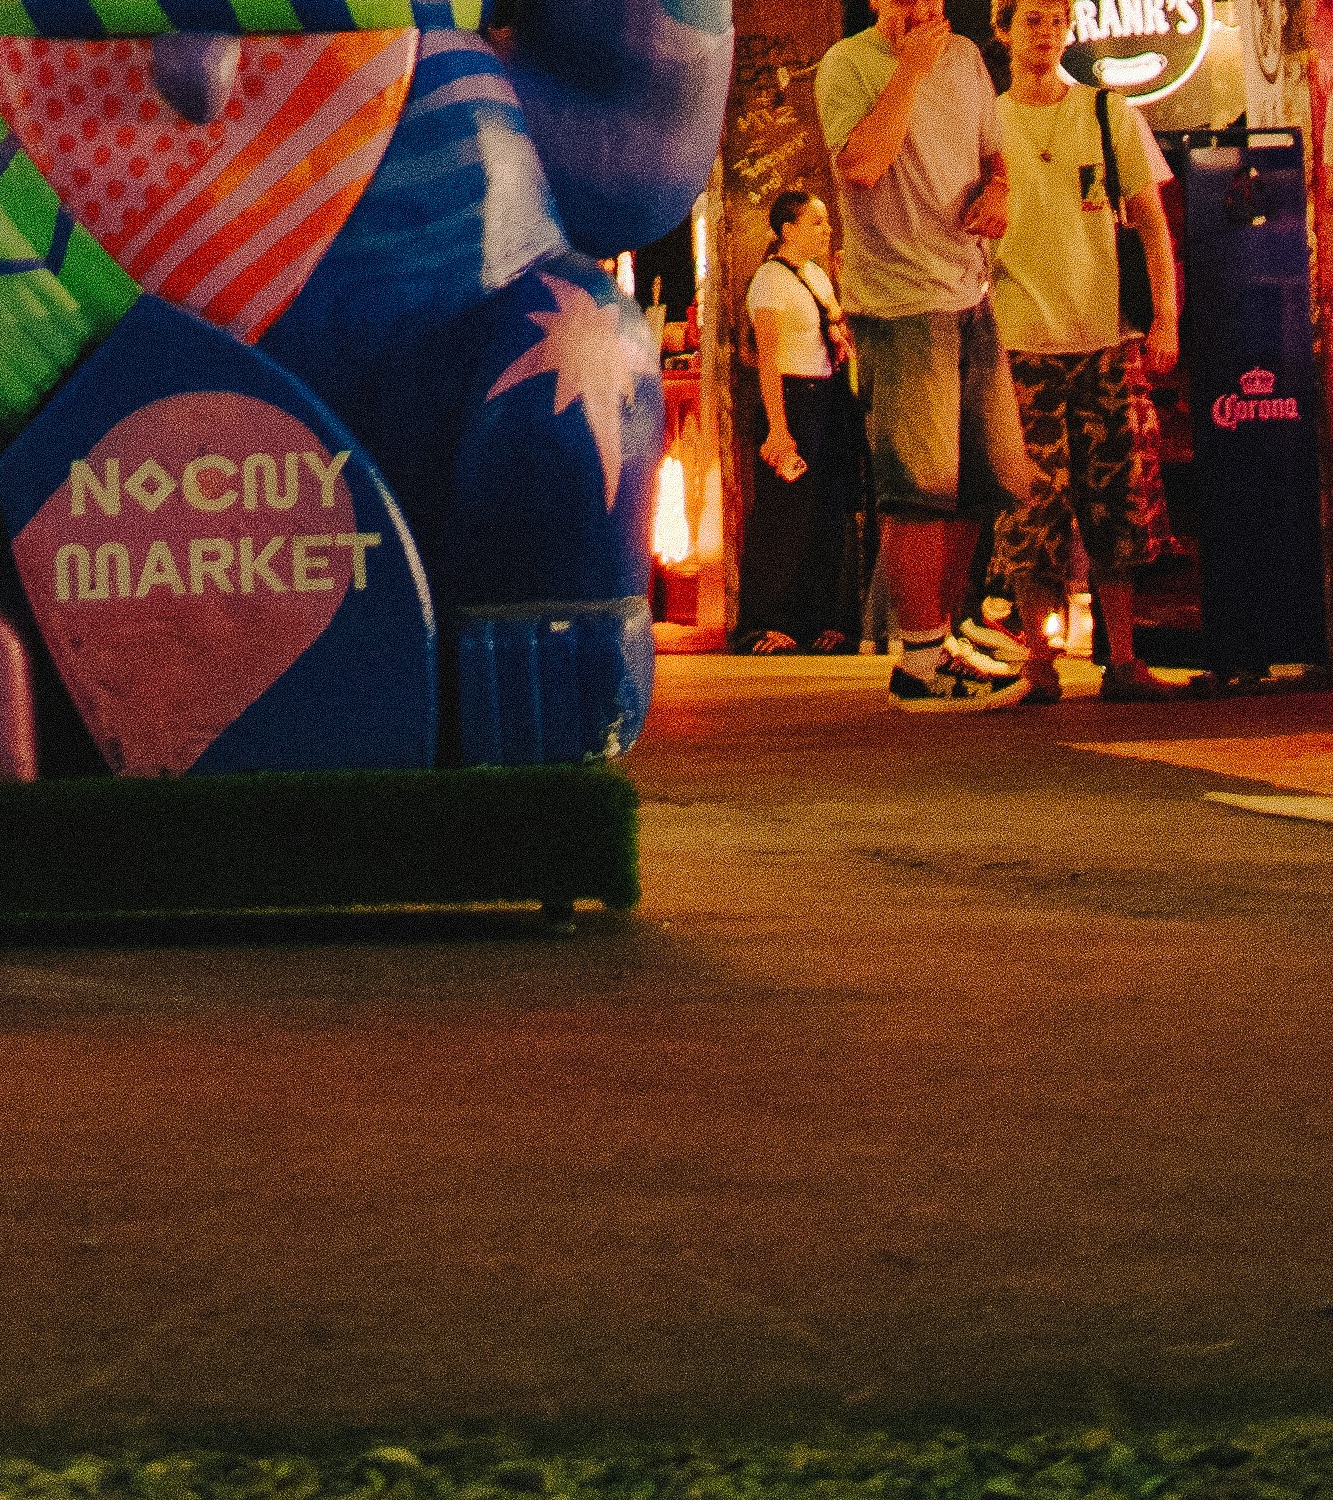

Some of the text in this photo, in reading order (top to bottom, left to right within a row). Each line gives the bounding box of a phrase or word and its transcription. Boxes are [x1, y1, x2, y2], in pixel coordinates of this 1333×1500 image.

[1211, 393, 1301, 431] Corona
[69, 449, 353, 518] NOCNY
[54, 532, 382, 602] MARKET
